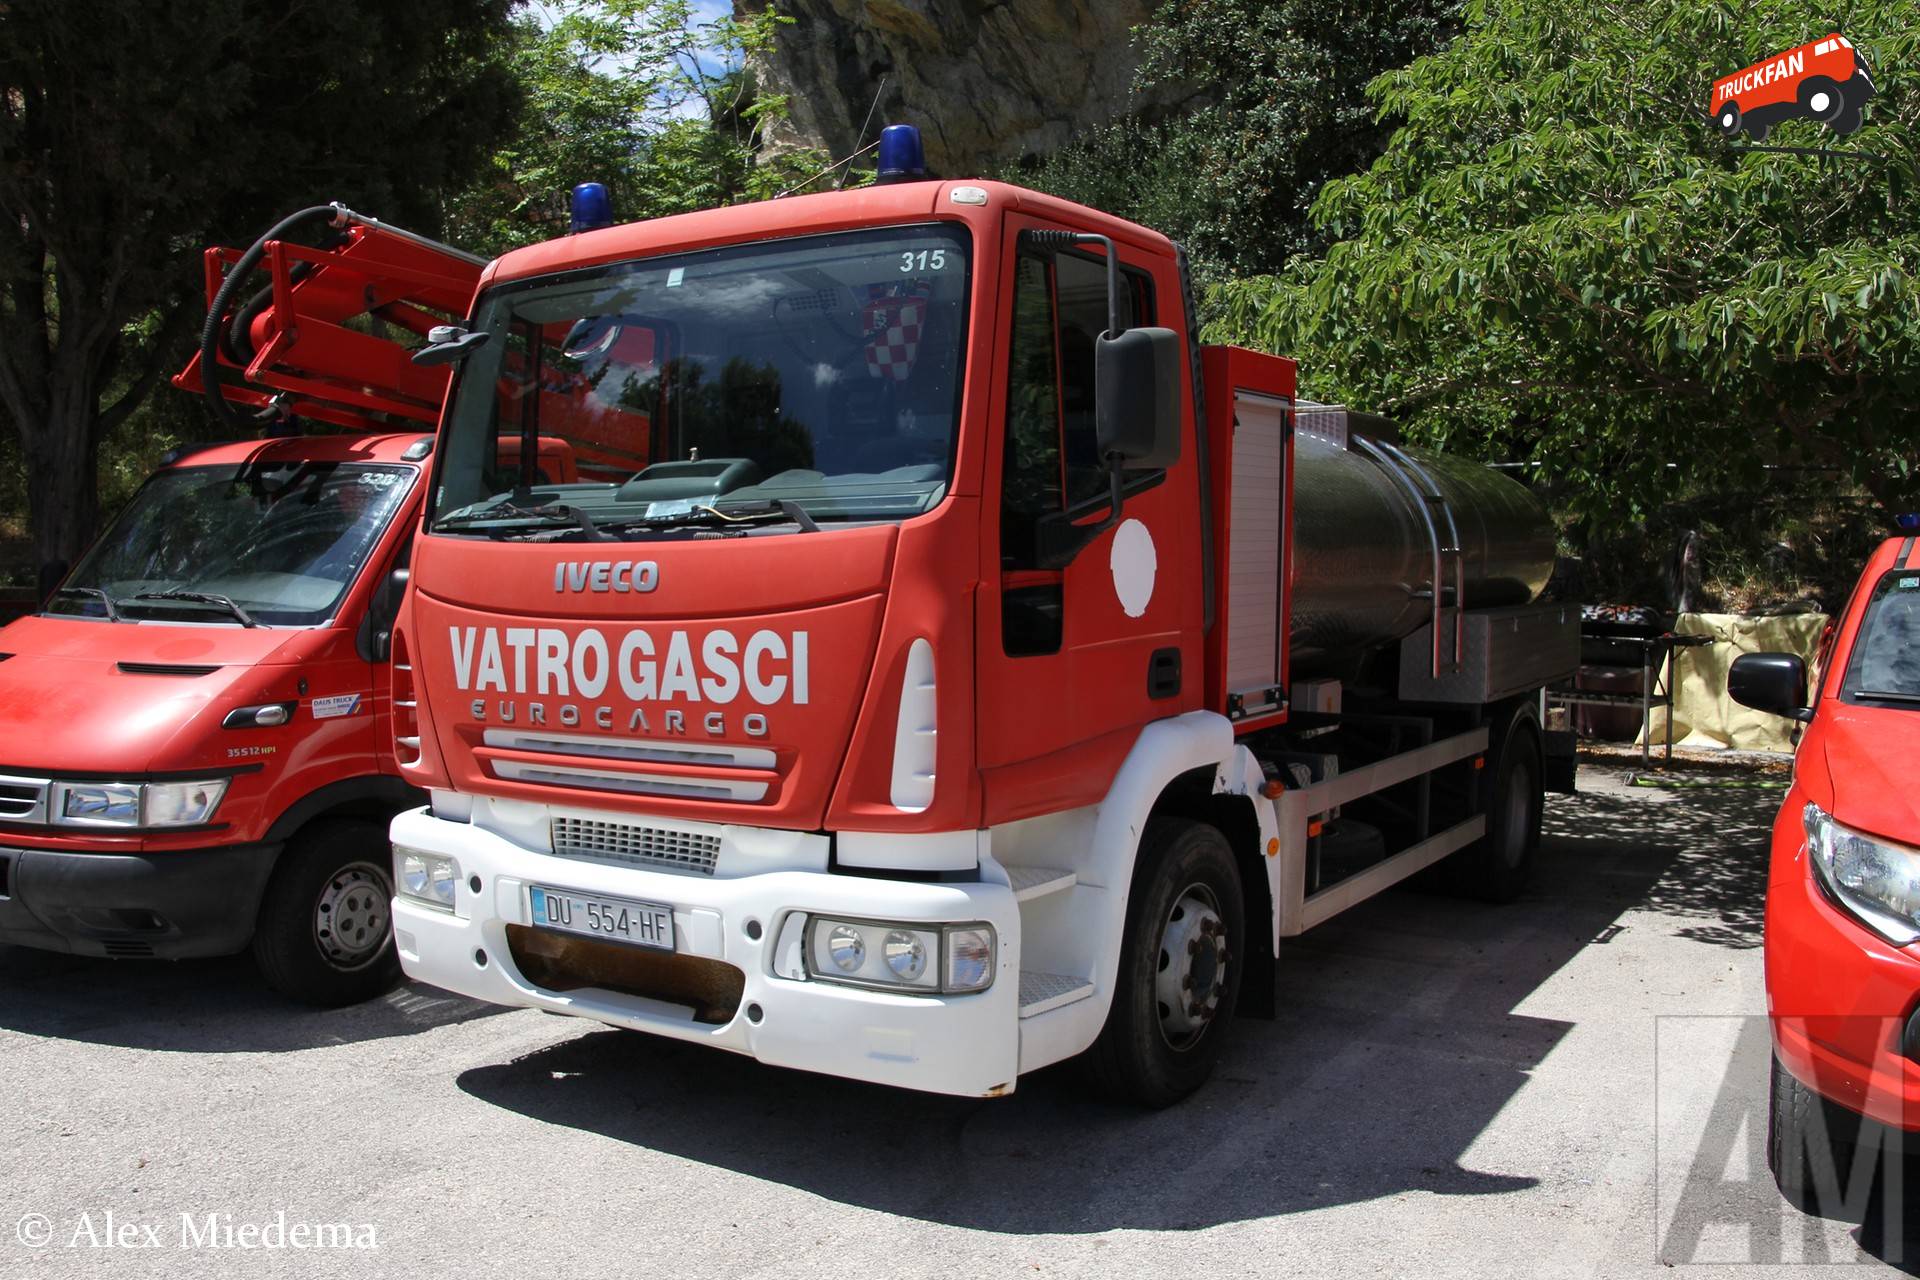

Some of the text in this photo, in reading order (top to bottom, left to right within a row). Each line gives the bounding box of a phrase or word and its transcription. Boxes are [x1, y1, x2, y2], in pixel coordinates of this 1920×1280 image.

[900, 249, 946, 272] 315
[555, 560, 659, 593] IVECO
[470, 699, 770, 736] EUROCARGO
[547, 895, 666, 941] DU 554-HF
